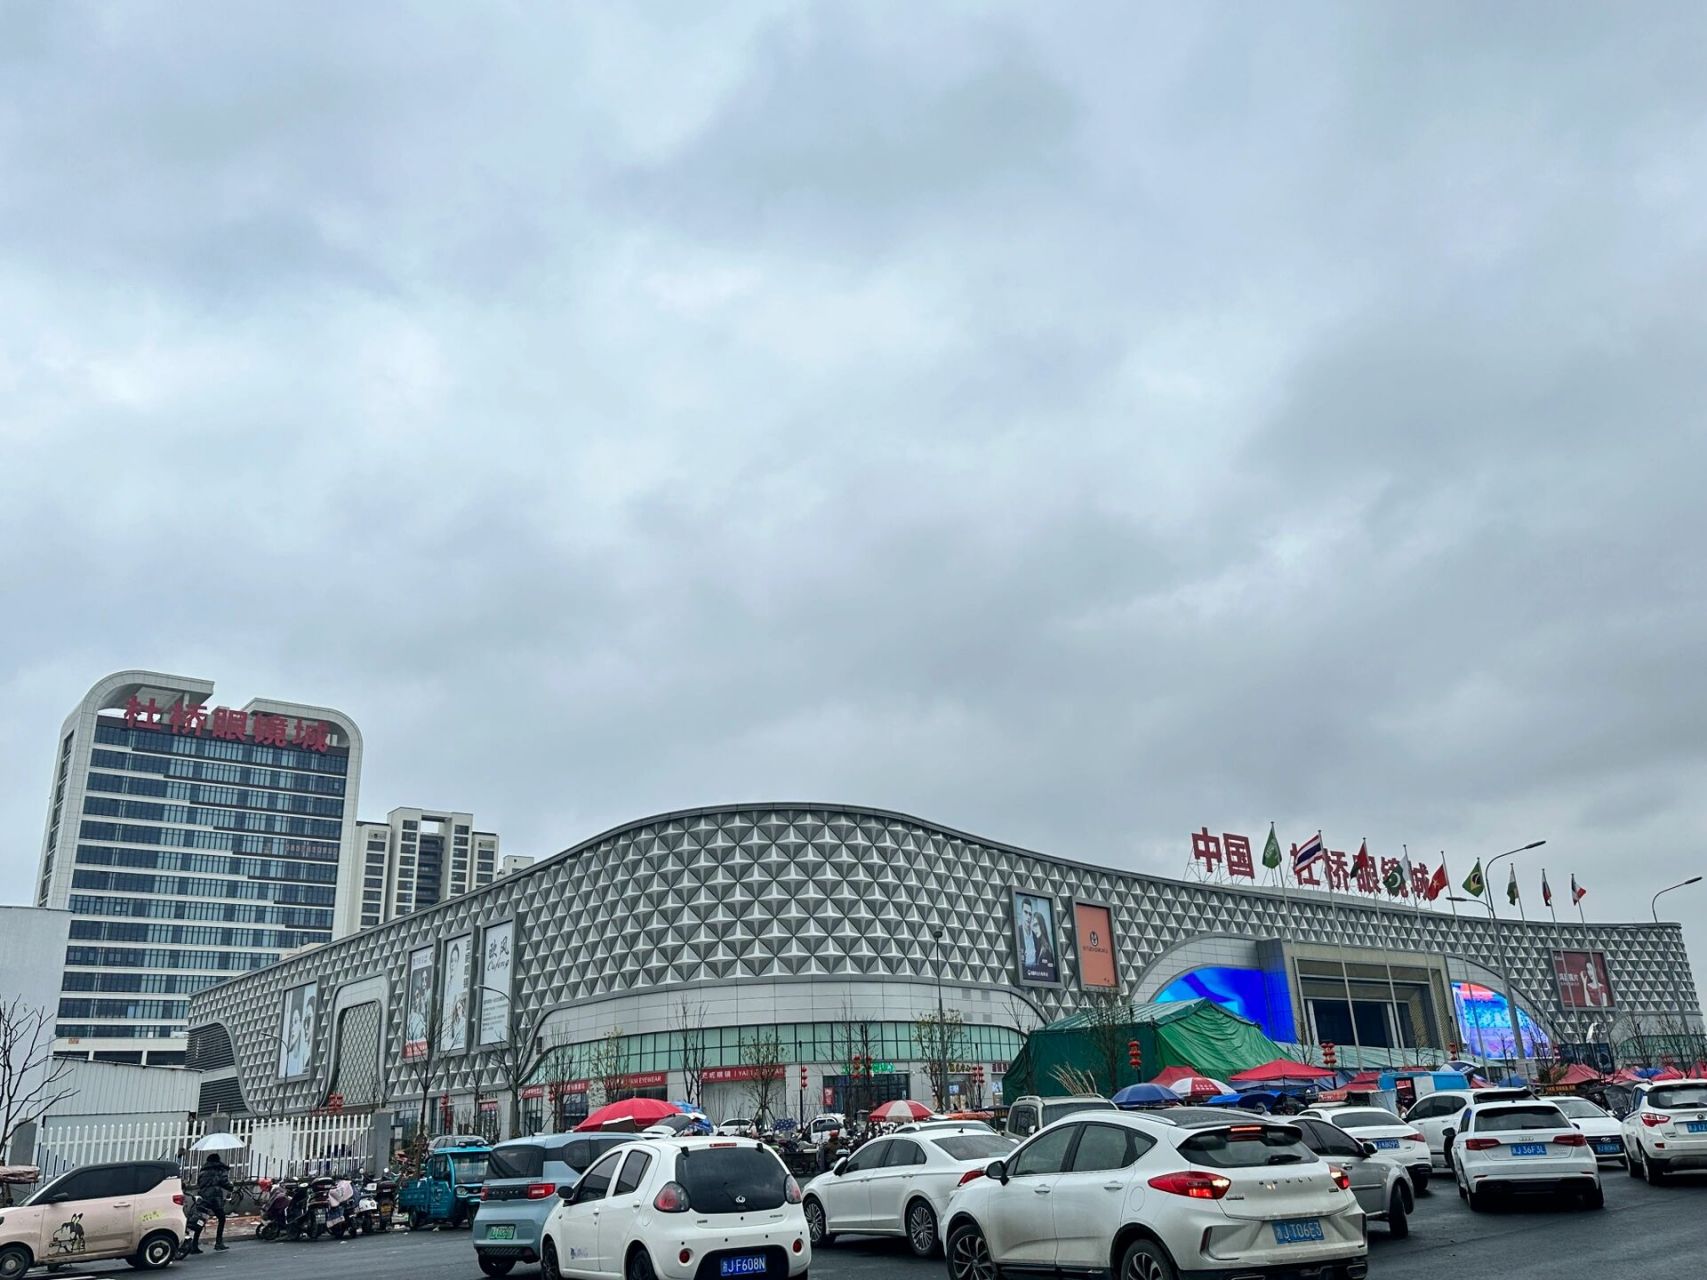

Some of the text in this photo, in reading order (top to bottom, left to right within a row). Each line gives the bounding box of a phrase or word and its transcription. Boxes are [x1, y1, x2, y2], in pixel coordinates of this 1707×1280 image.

[124, 695, 329, 752] 杜桥眼镜城
[1191, 826, 1255, 879] 中国
